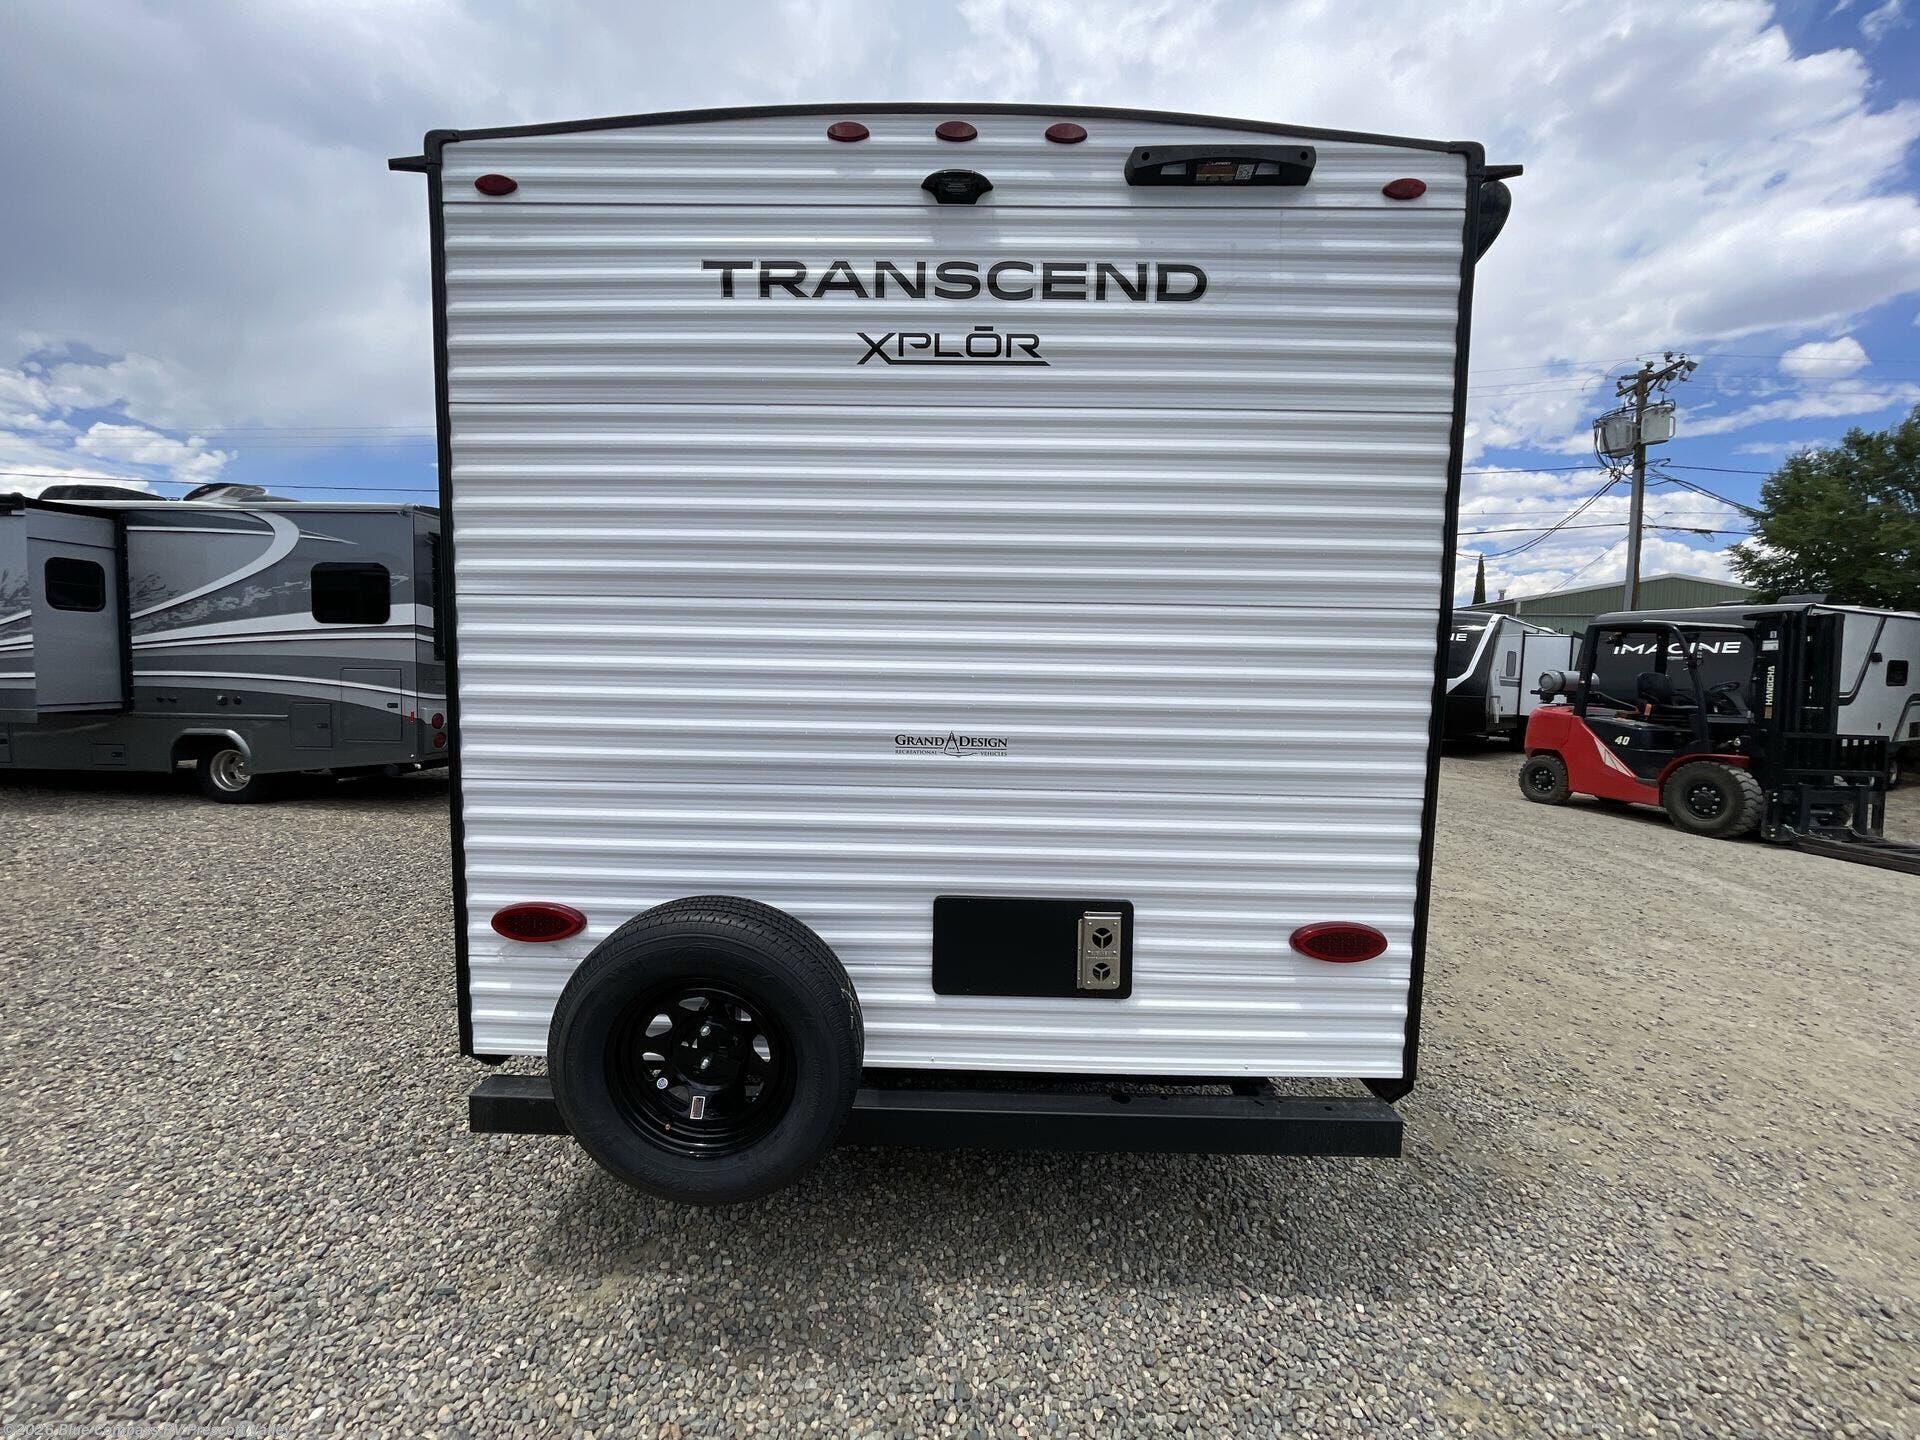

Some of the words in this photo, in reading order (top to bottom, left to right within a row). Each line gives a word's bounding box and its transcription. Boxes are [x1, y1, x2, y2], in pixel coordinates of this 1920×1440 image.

[702, 260, 1208, 302] TRANSCEND
[1765, 665, 1776, 706] HANGCHA
[895, 734, 945, 747] GRAND
[959, 735, 1008, 748] DESIGN
[1614, 735, 1630, 746] 40
